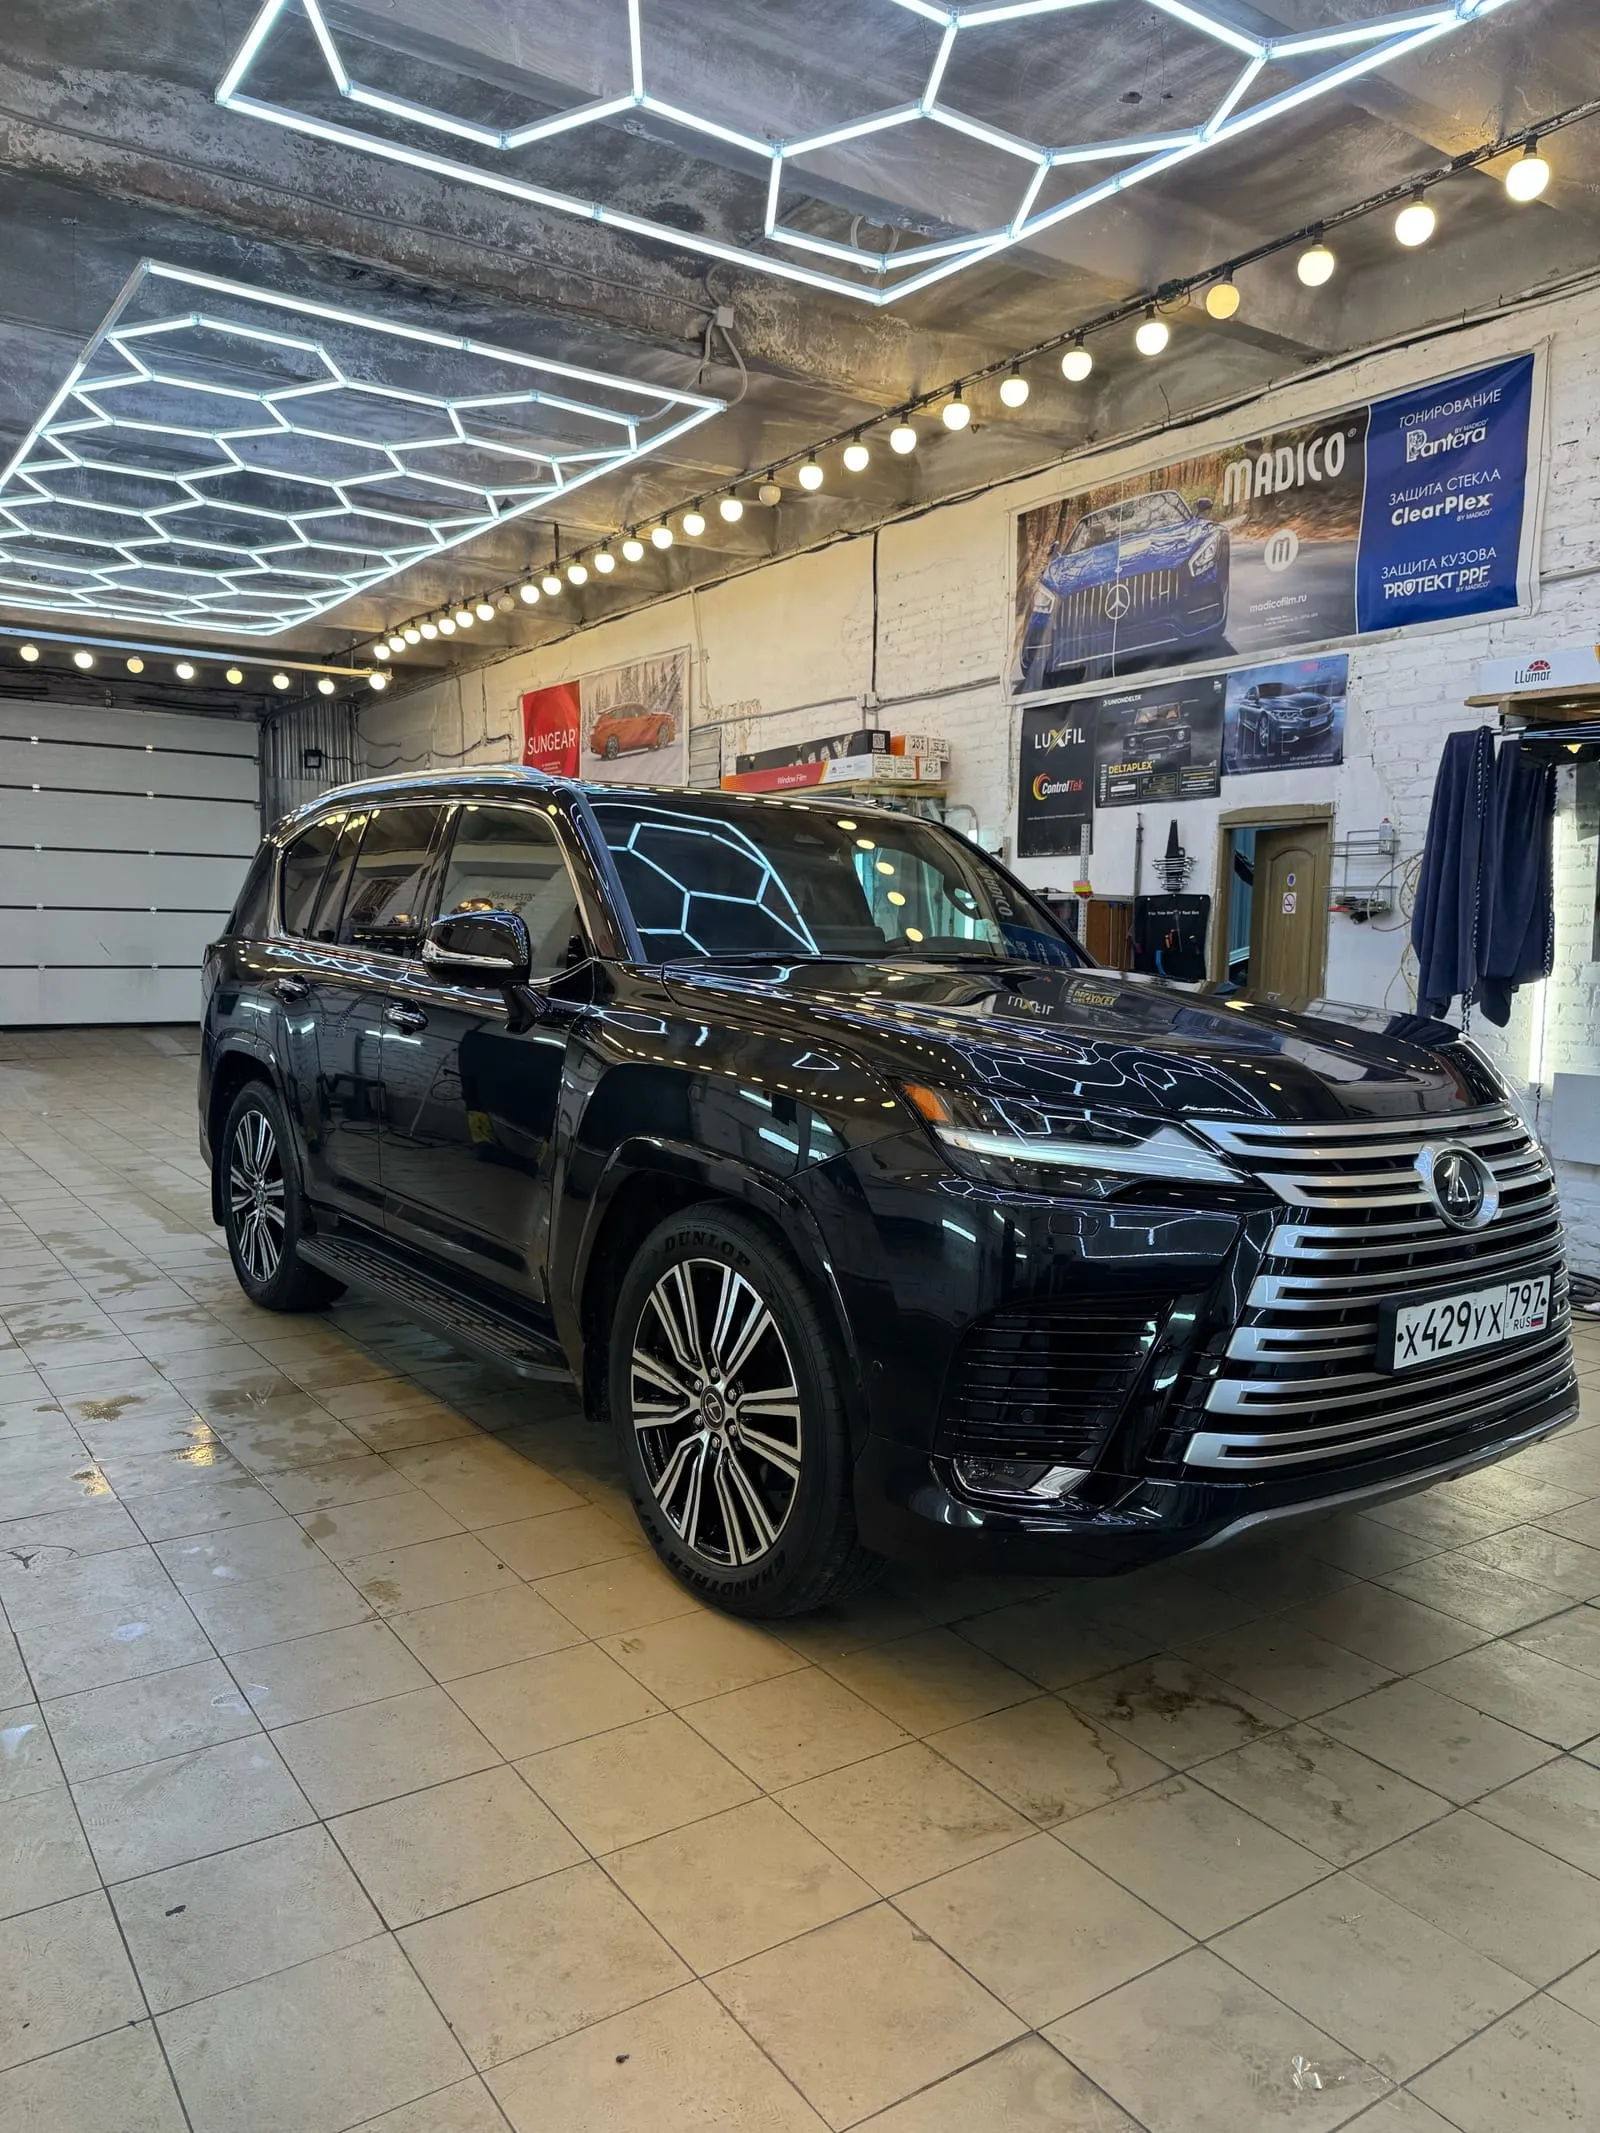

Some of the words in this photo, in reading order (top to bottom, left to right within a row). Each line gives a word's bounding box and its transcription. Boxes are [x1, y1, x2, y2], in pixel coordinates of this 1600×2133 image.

[1399, 388, 1502, 429] ТОНИРОВАНИЕ
[1406, 426, 1486, 463] Pantera
[1223, 431, 1345, 506] MADICO
[1388, 481, 1443, 506] ЗАЩИТА
[1446, 468, 1501, 491] СТЕКЛА
[1391, 493, 1490, 526] ClearPlex
[1381, 558, 1437, 579] ЗАЩИТА
[1441, 546, 1496, 568] КУЗОВА
[1383, 572, 1456, 599] PROTEKT
[1459, 564, 1491, 586] PPF
[1249, 594, 1307, 613] madicofilm.ru
[1514, 670, 1551, 684] LLumar
[527, 729, 576, 756] SUNGEAR
[1034, 725, 1086, 751] LUXFIL
[1108, 761, 1153, 775] DELTAPLEX
[1042, 779, 1084, 795] ControlTek
[665, 1231, 751, 1266] DUNLOP
[1509, 1281, 1544, 1319] 797
[1513, 1316, 1531, 1331] RUS
